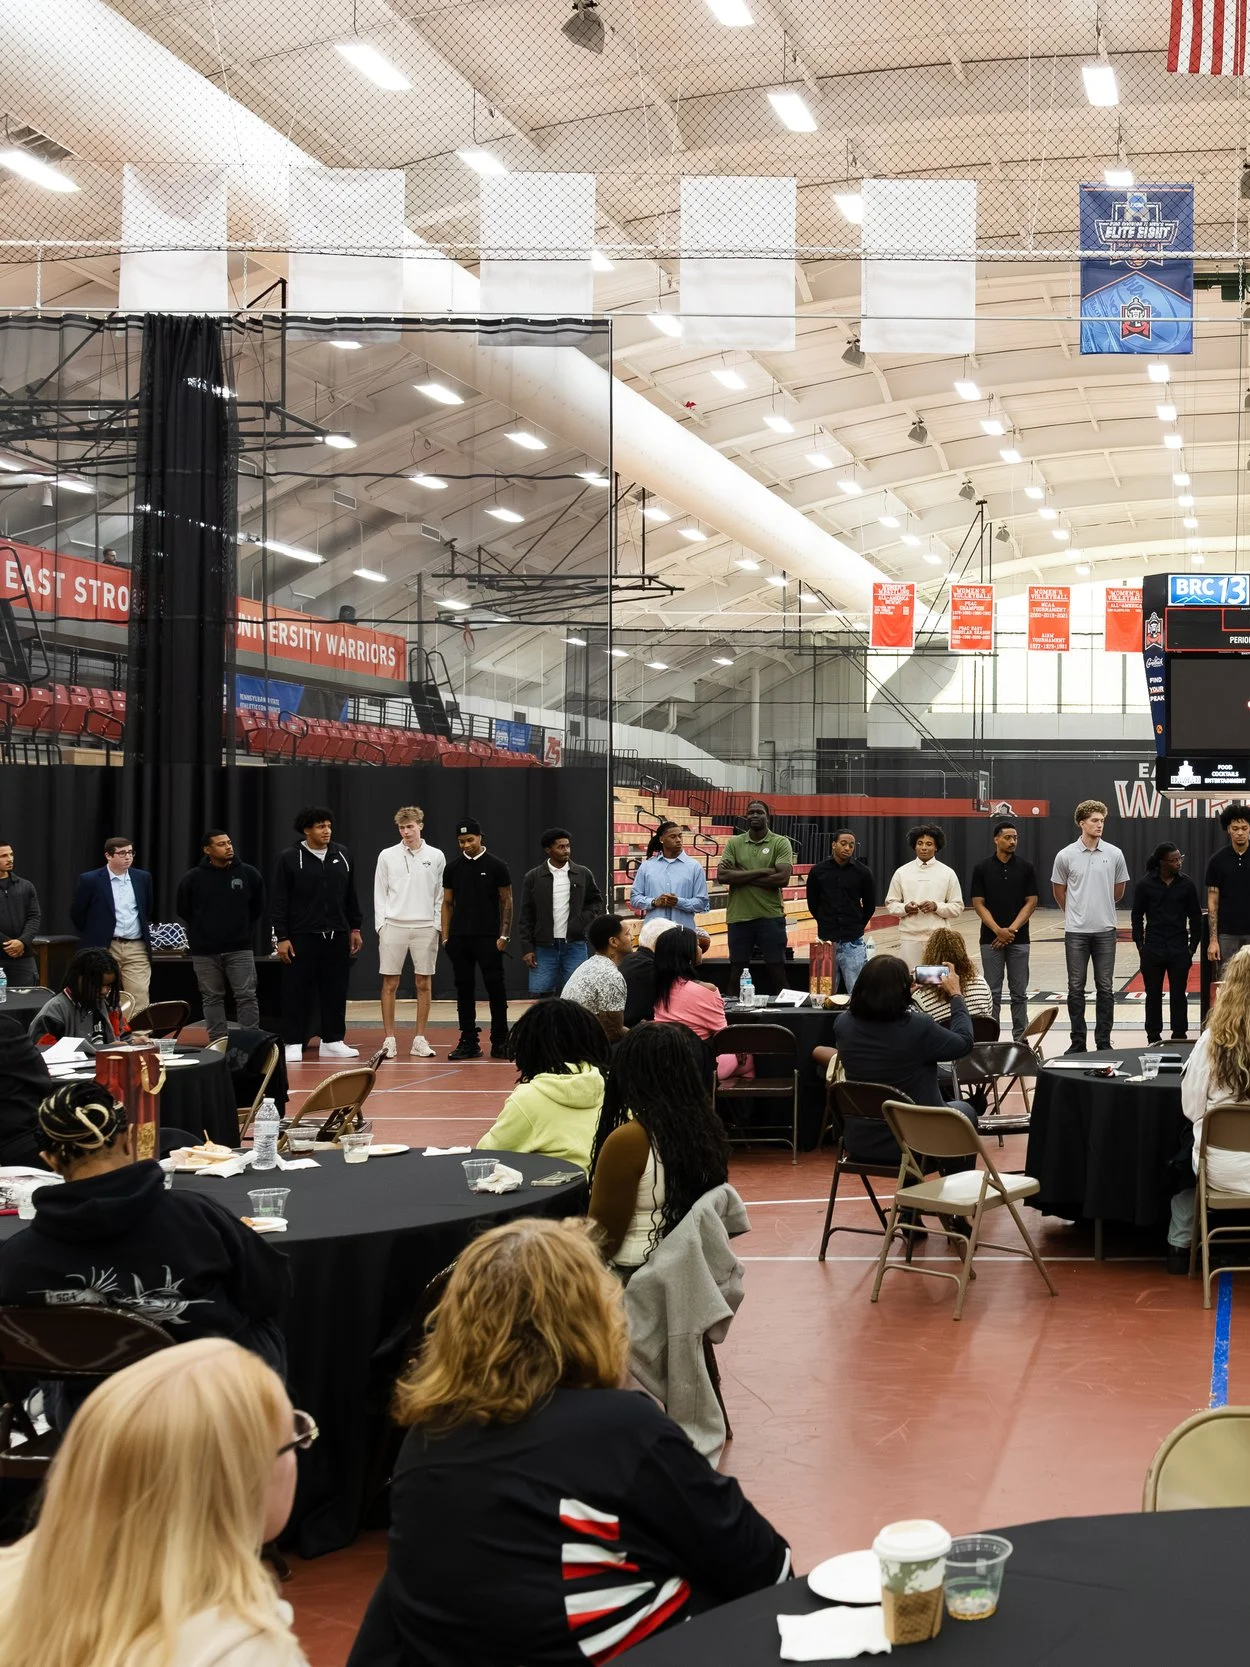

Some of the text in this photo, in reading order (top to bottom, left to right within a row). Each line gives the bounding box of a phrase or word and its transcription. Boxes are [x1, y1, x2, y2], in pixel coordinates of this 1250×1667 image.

[1105, 226, 1170, 238] ELITE EIGHT
[6, 560, 128, 612] EAST STRO
[1176, 576, 1247, 604] BRC 13
[325, 633, 396, 667] WARRIORS
